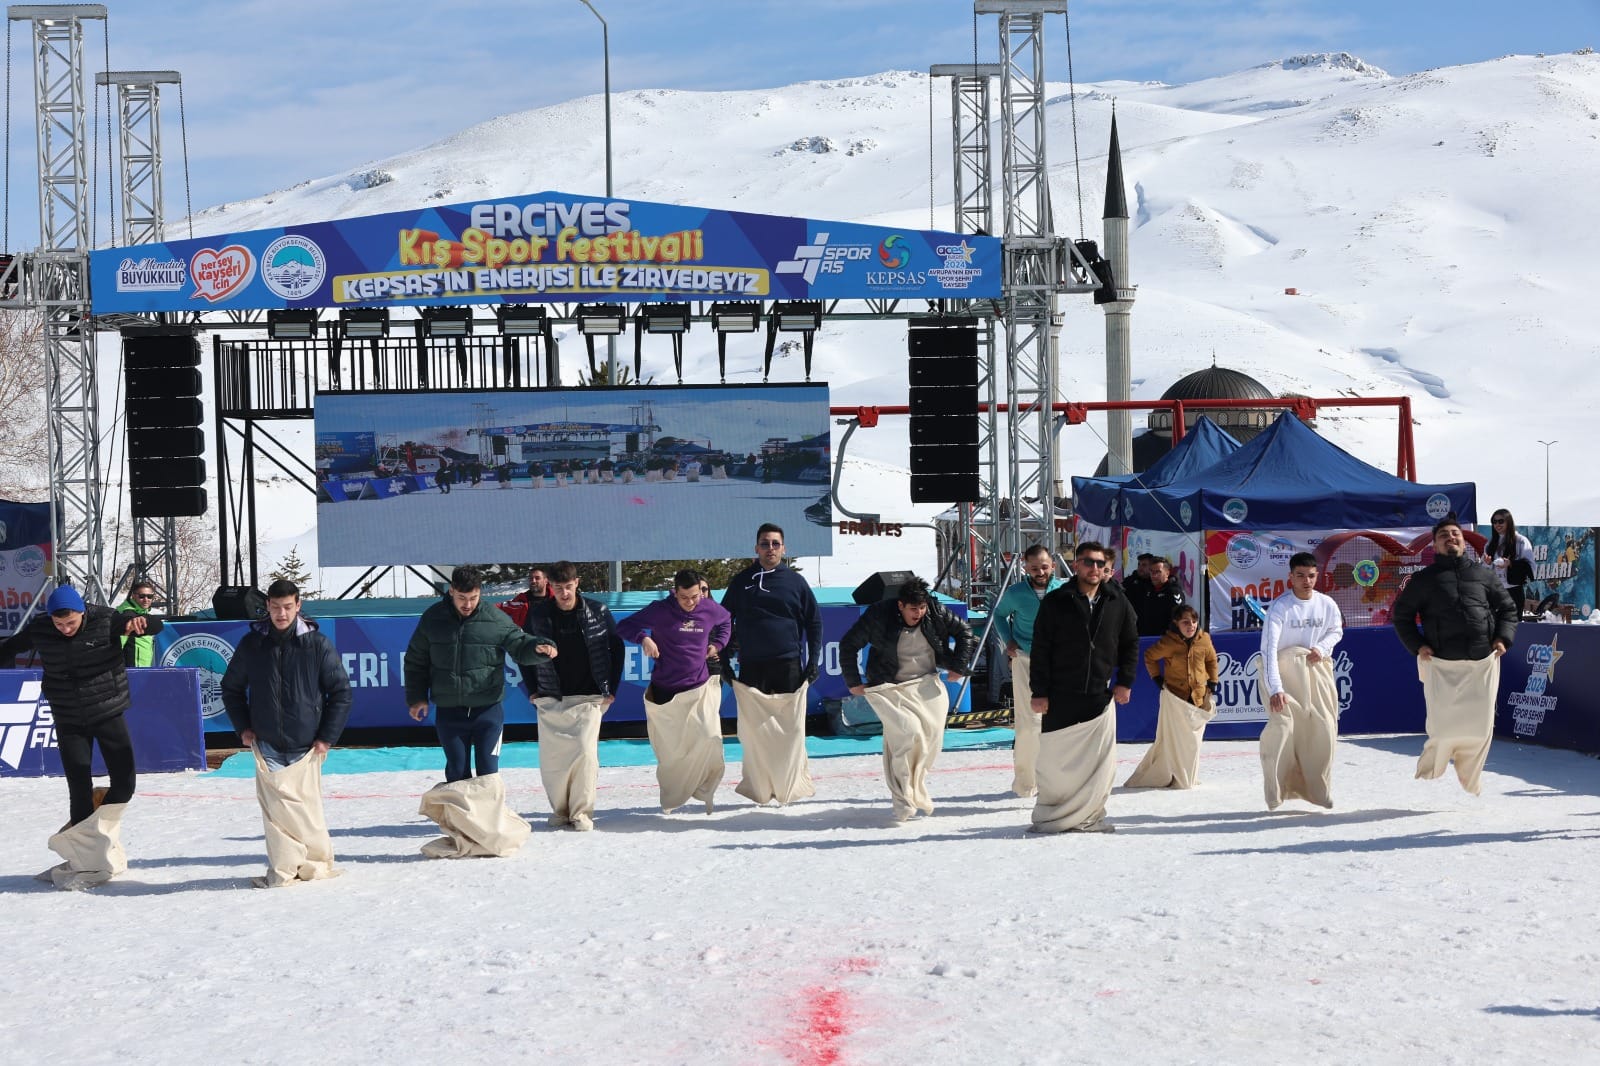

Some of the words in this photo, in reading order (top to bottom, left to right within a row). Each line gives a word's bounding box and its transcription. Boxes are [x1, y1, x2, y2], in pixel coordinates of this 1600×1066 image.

[461, 228, 549, 268] Spor
[824, 247, 872, 260] SPOR
[937, 246, 964, 255] aces
[201, 261, 216, 270] her
[945, 260, 966, 268] 2024
[1527, 645, 1553, 664] aces
[1526, 676, 1547, 693] 2024
